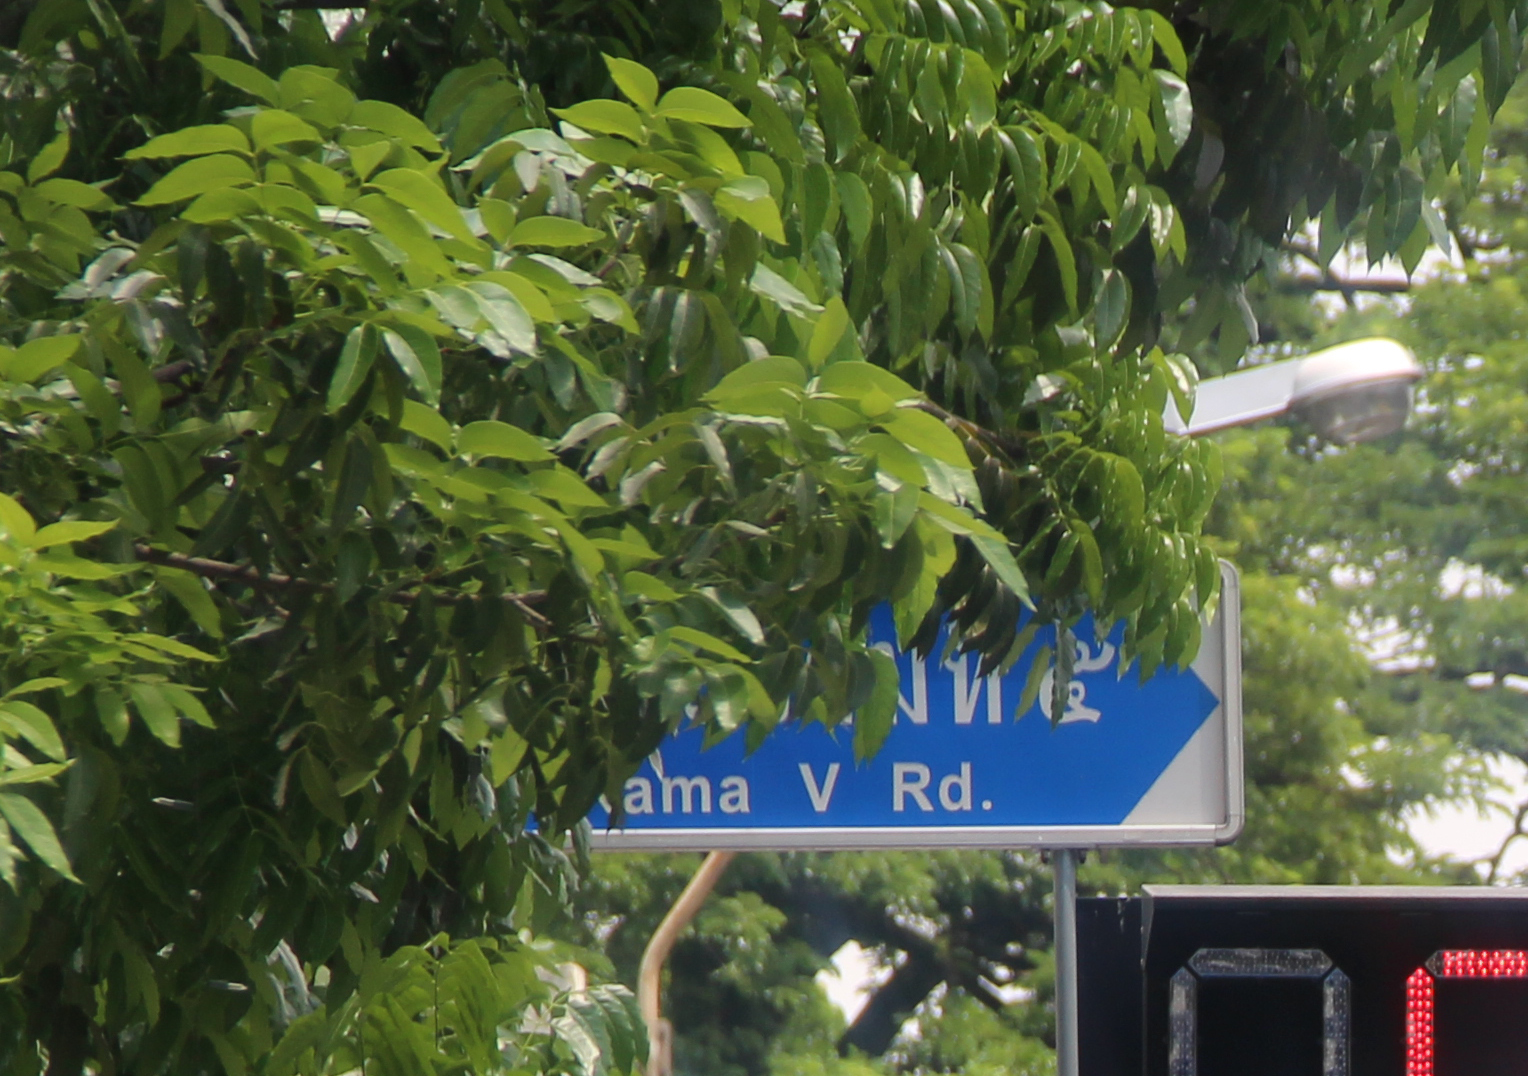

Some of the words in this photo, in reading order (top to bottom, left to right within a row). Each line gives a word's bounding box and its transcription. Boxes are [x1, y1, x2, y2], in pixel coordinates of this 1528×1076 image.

[599, 774, 751, 815] ama
[798, 762, 840, 812] V
[892, 762, 993, 813] Rd.
